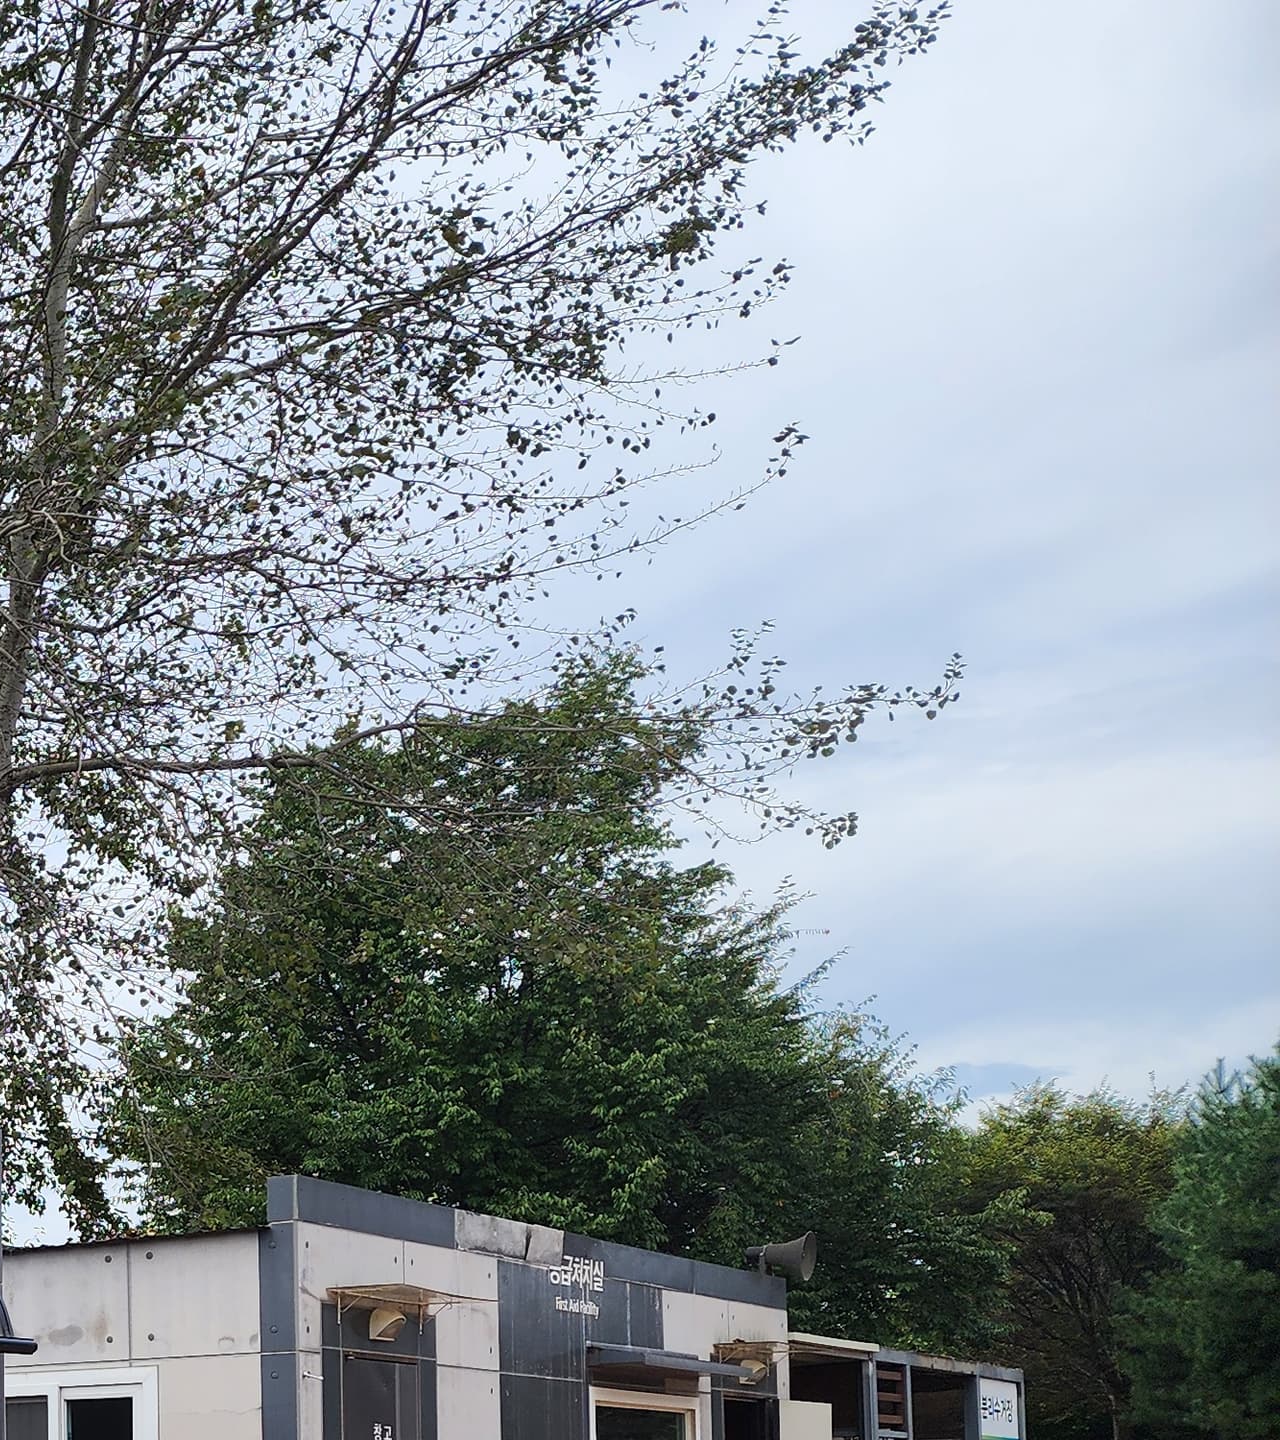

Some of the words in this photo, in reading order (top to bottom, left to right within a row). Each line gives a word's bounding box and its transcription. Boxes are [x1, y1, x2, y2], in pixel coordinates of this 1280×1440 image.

[555, 1296, 568, 1311] First
[569, 1299, 580, 1313] Aid
[580, 1300, 599, 1320] Facility
[981, 1396, 1014, 1423] 분리수거장
